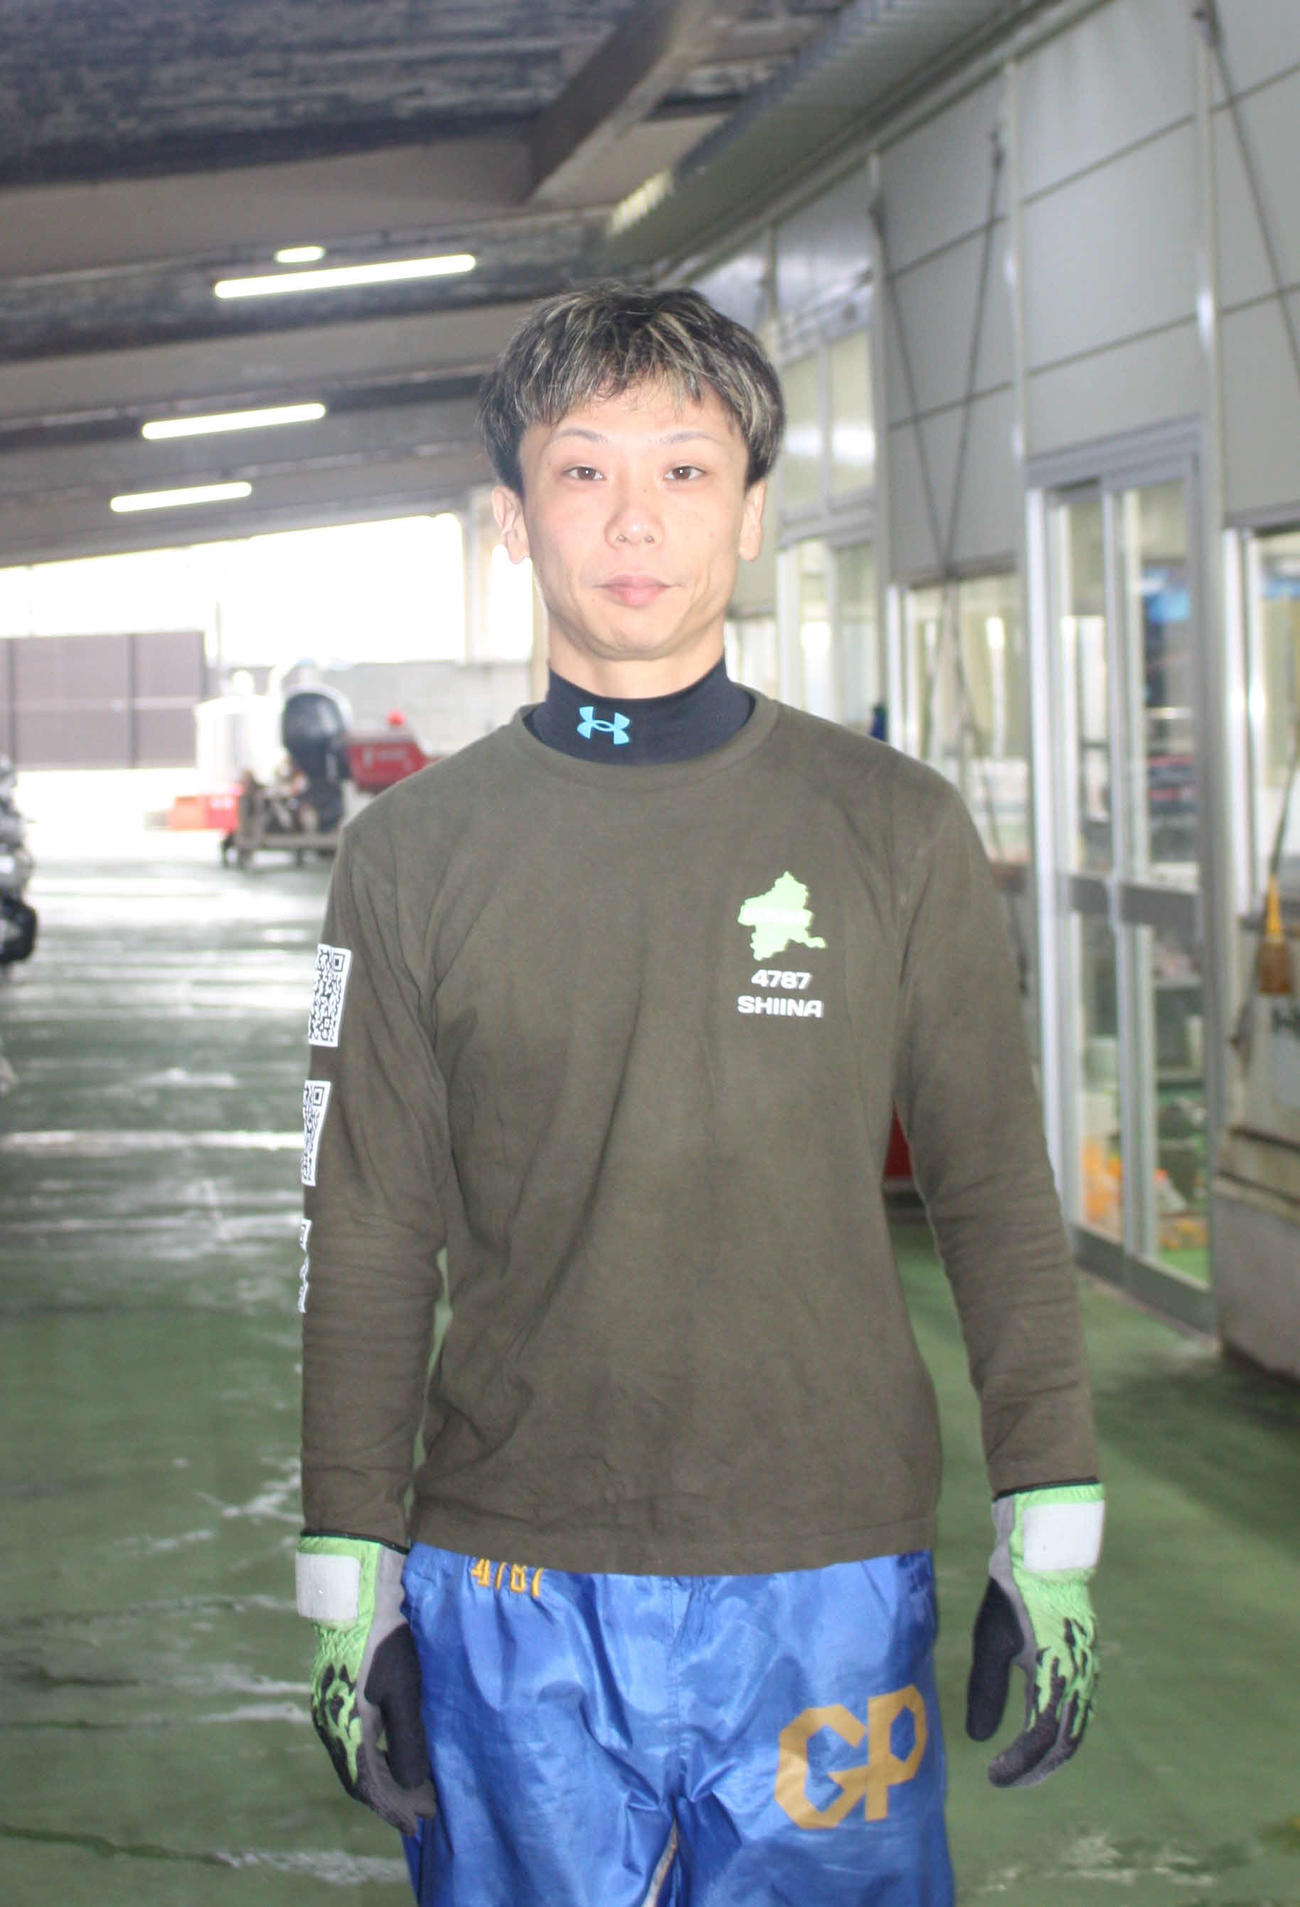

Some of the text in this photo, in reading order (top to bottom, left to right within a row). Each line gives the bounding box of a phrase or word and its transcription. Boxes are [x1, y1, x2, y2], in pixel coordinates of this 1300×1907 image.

[751, 969, 811, 989] 4787
[738, 995, 823, 1018] SHIINA
[775, 1684, 928, 1829] GP
